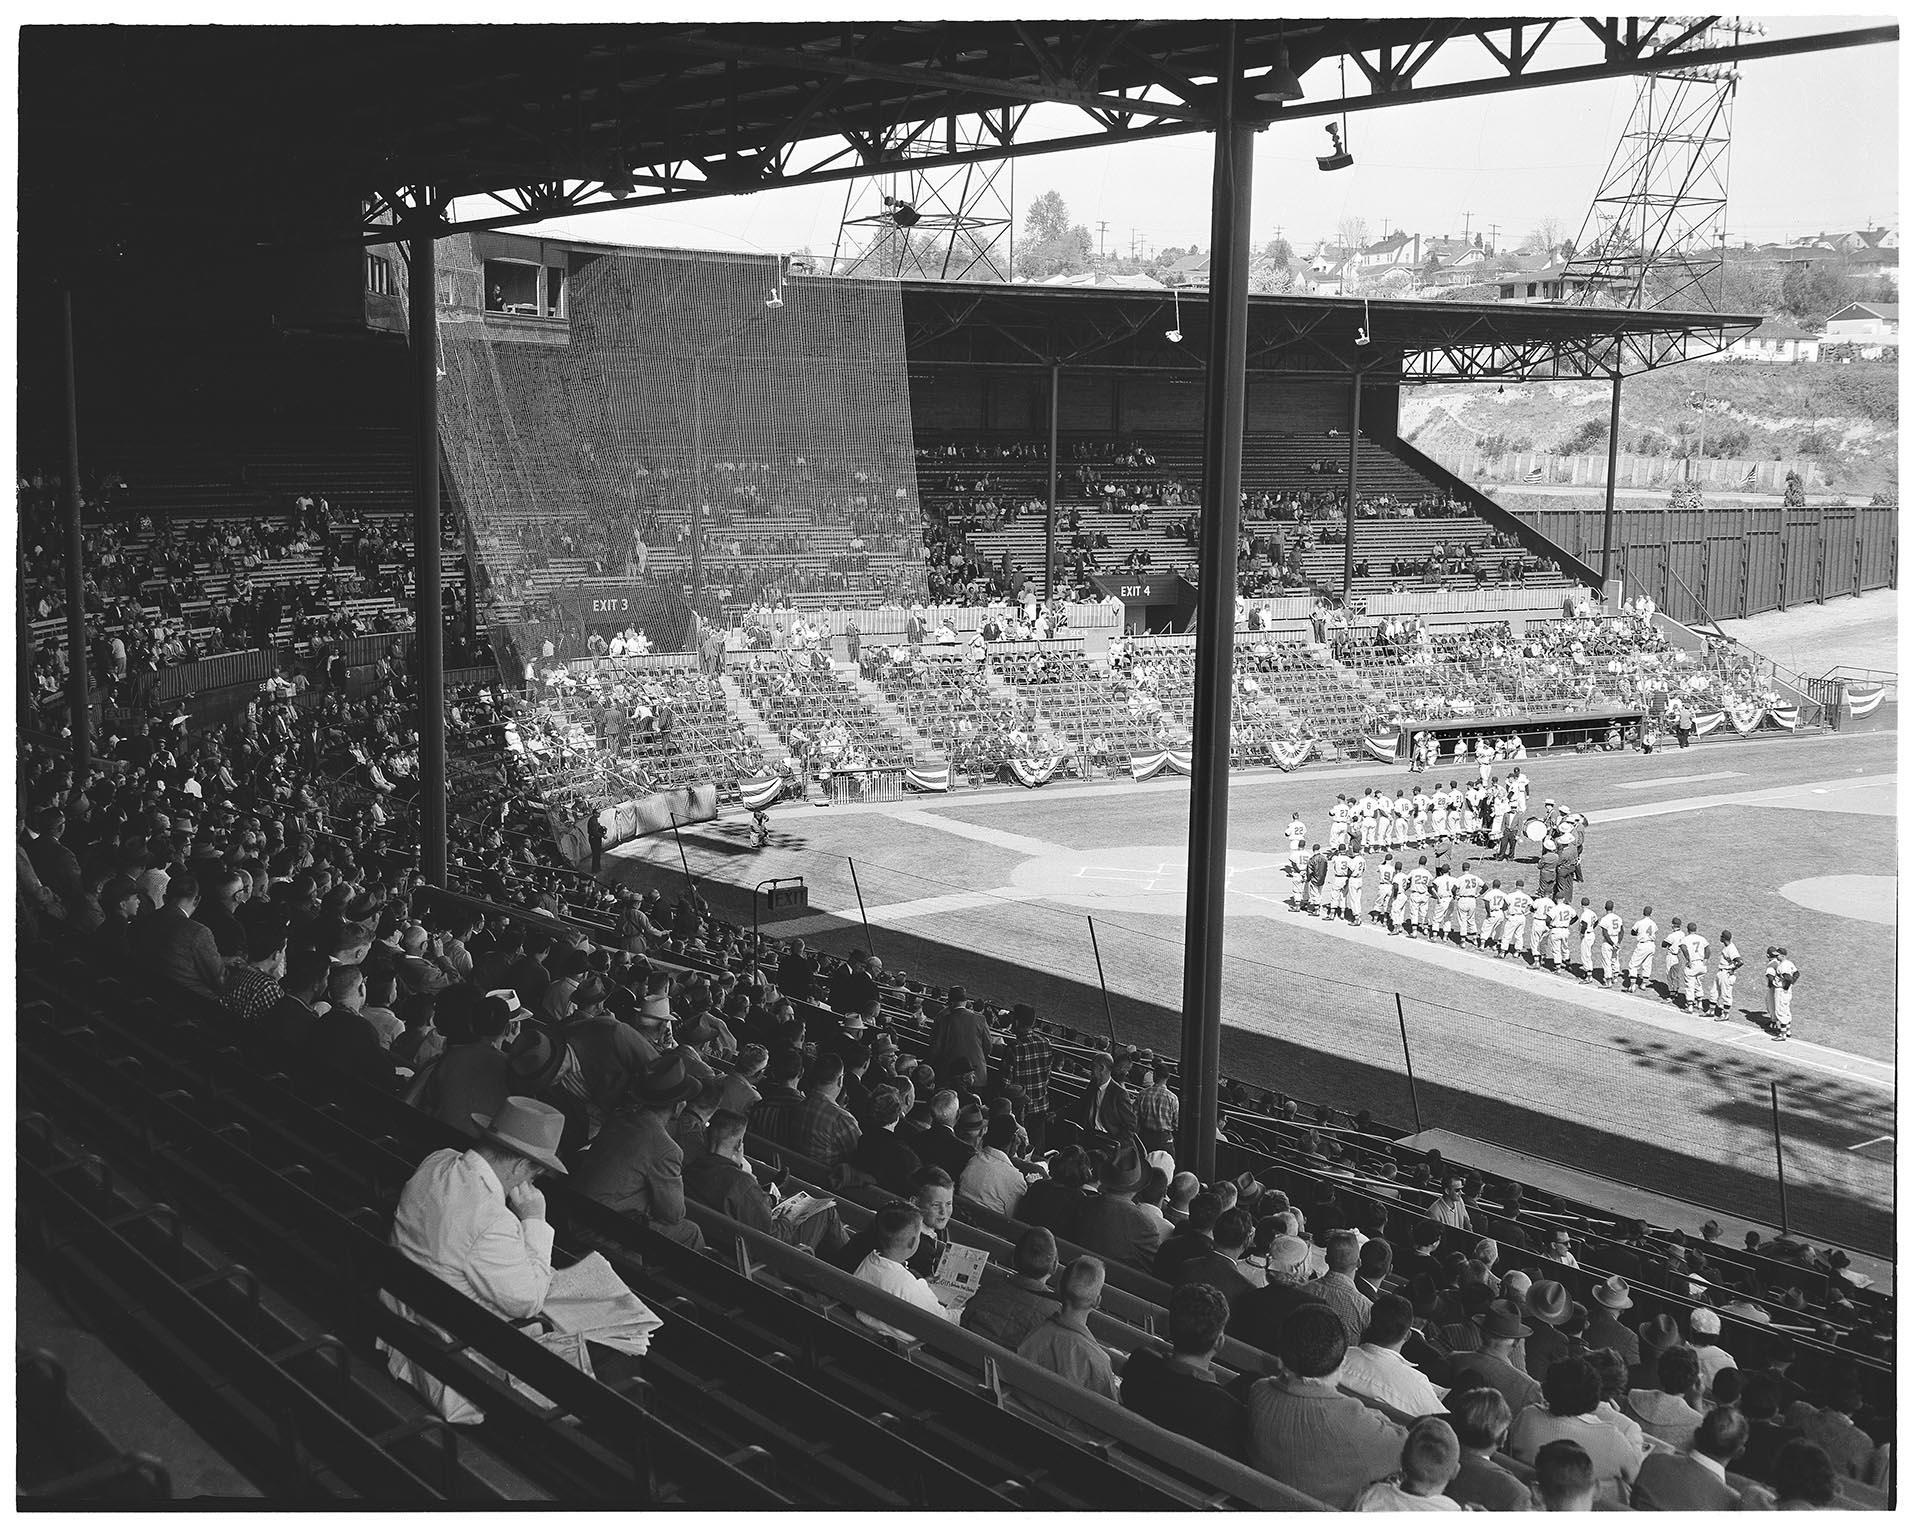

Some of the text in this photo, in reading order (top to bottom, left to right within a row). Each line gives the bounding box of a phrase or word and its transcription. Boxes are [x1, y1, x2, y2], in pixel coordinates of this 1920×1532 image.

[1121, 585, 1151, 597] EXIT 4
[593, 598, 628, 612] EXIT 3
[1366, 802, 1372, 810] 6
[1401, 803, 1409, 811] 16
[1340, 809, 1349, 818] 27
[1294, 826, 1304, 835] 22
[1340, 861, 1347, 871] 3
[1414, 874, 1429, 885] 23
[1464, 879, 1477, 890] 25
[775, 890, 805, 907] EXIT
[1492, 895, 1503, 906] 17
[1514, 897, 1528, 909] 22
[1558, 910, 1570, 922] 12
[1612, 919, 1619, 930] 5
[1692, 941, 1701, 953] 7
